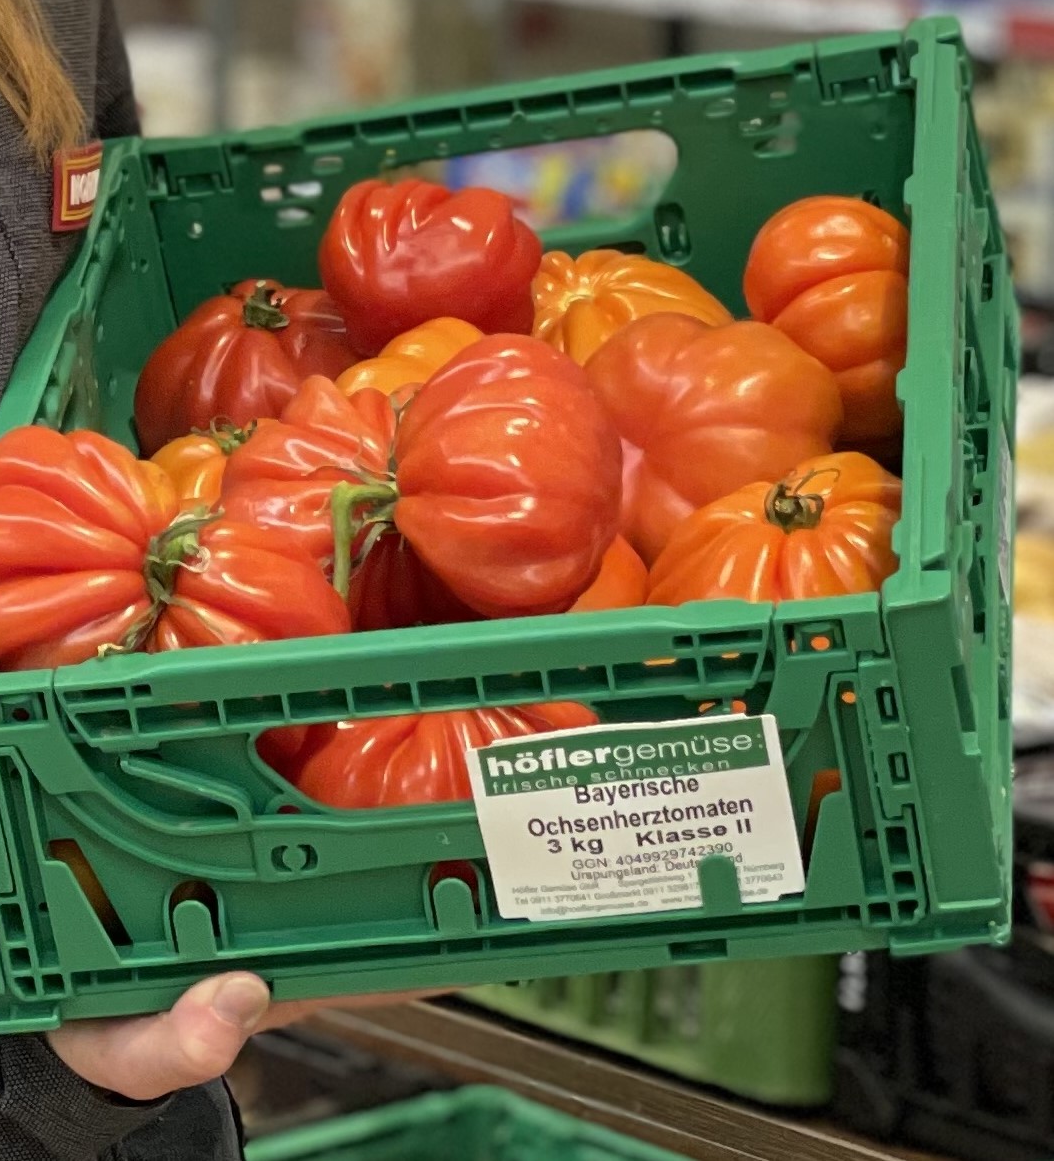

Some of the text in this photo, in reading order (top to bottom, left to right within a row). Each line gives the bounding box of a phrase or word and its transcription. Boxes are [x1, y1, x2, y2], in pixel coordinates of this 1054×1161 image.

[493, 759, 730, 794] frische schmecken
[574, 775, 699, 806] Bayerische
[527, 798, 753, 836] Ochsenherztomaten
[547, 818, 752, 854] 3 kg Klasse II
